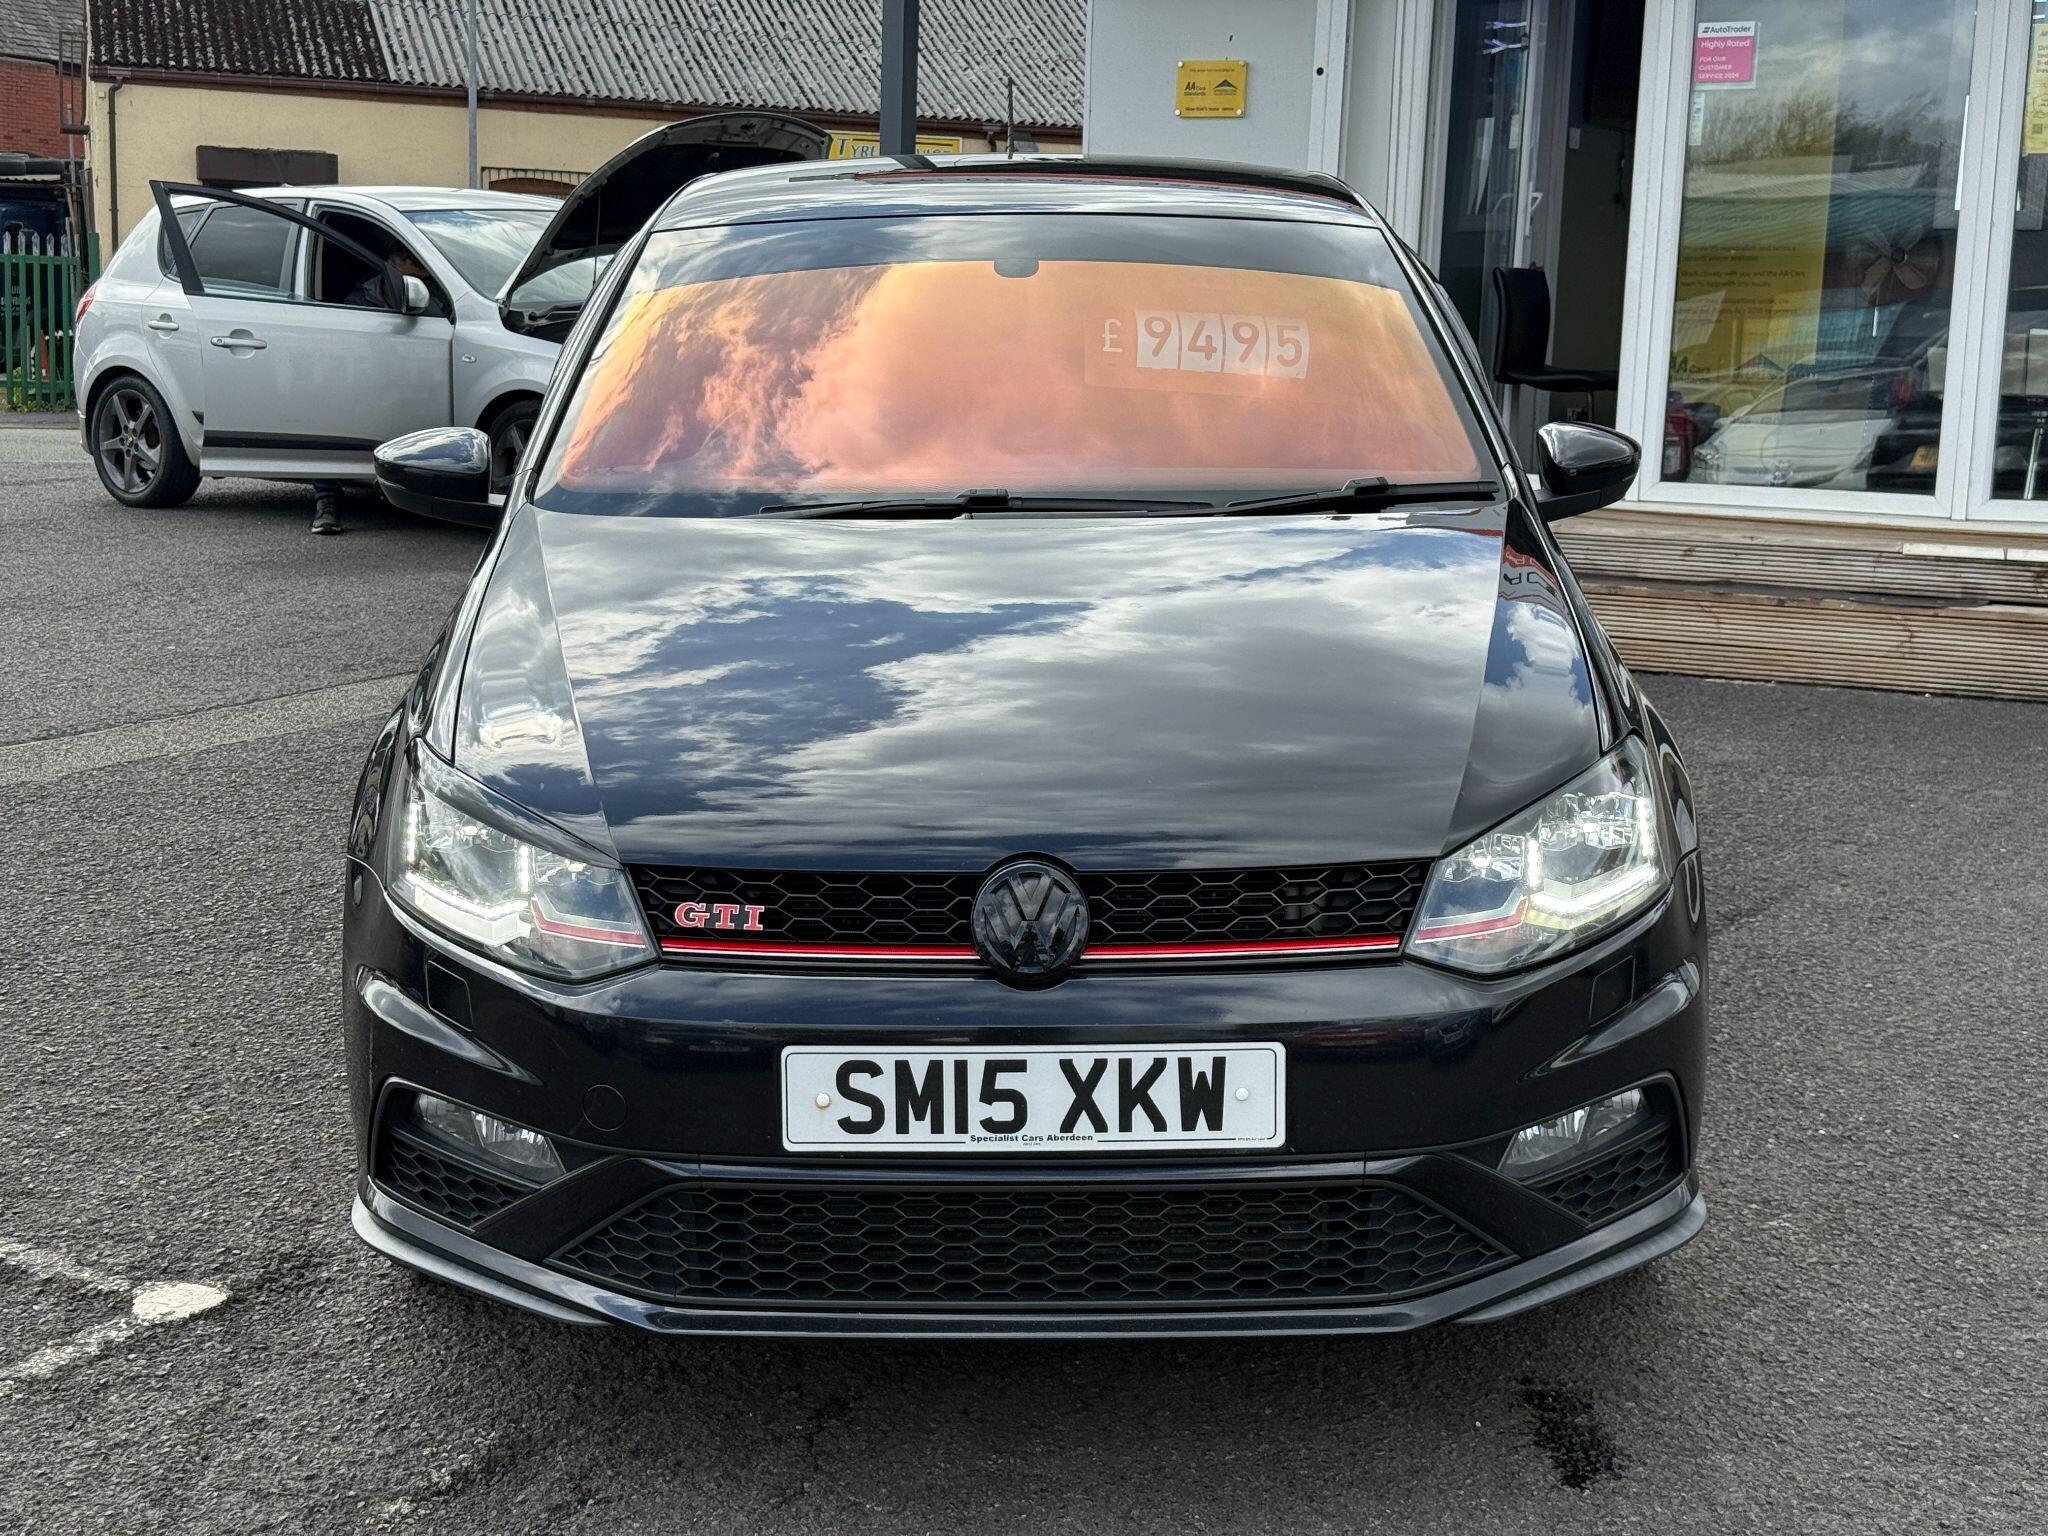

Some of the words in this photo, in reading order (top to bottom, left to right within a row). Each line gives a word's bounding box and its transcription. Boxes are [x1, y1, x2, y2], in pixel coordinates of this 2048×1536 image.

[1701, 40, 1725, 50] Highly
[1726, 39, 1750, 48] Rated
[674, 901, 765, 931] GTI
[835, 1059, 1028, 1135] SM15
[1059, 1056, 1227, 1134] XKW
[970, 1134, 1019, 1144] Specialist
[1021, 1134, 1044, 1142] Cars
[1046, 1134, 1093, 1142] Aberdeen
